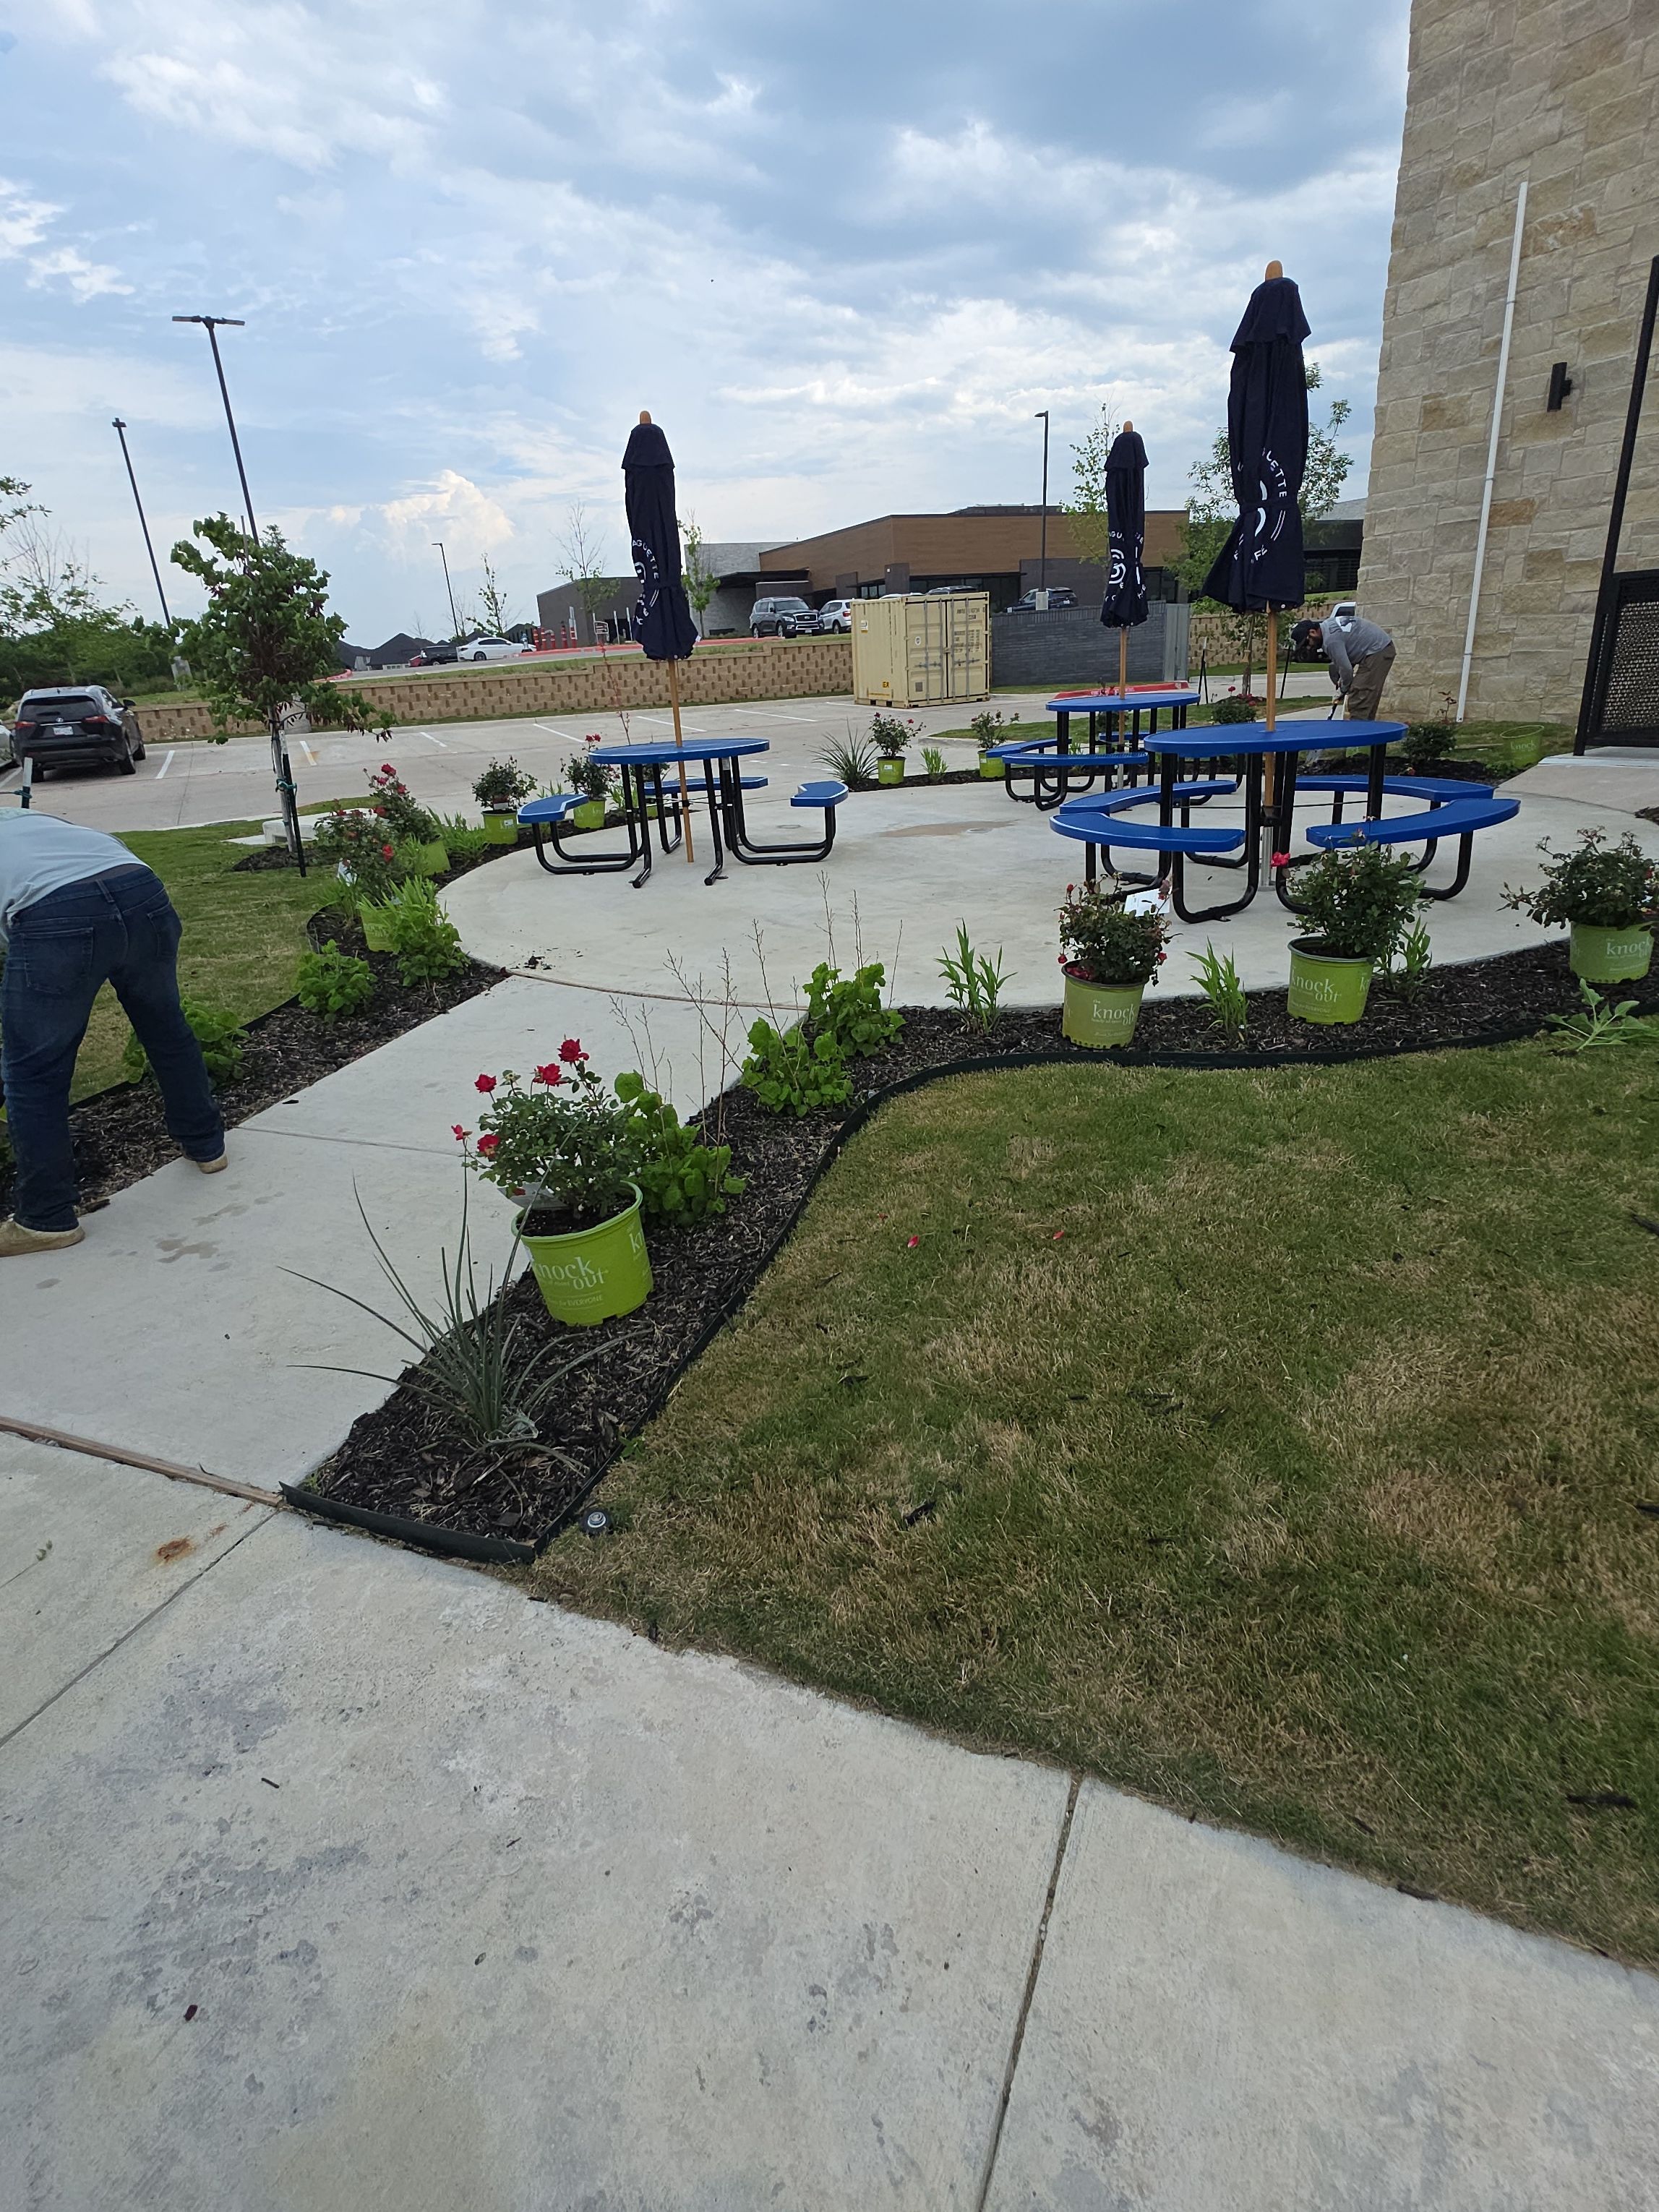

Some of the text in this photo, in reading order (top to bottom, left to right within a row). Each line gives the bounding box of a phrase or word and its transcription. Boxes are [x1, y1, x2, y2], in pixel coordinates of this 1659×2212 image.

[1316, 991, 1339, 1003] out
[1093, 1003, 1135, 1019] knock
[573, 1267, 605, 1290] out
